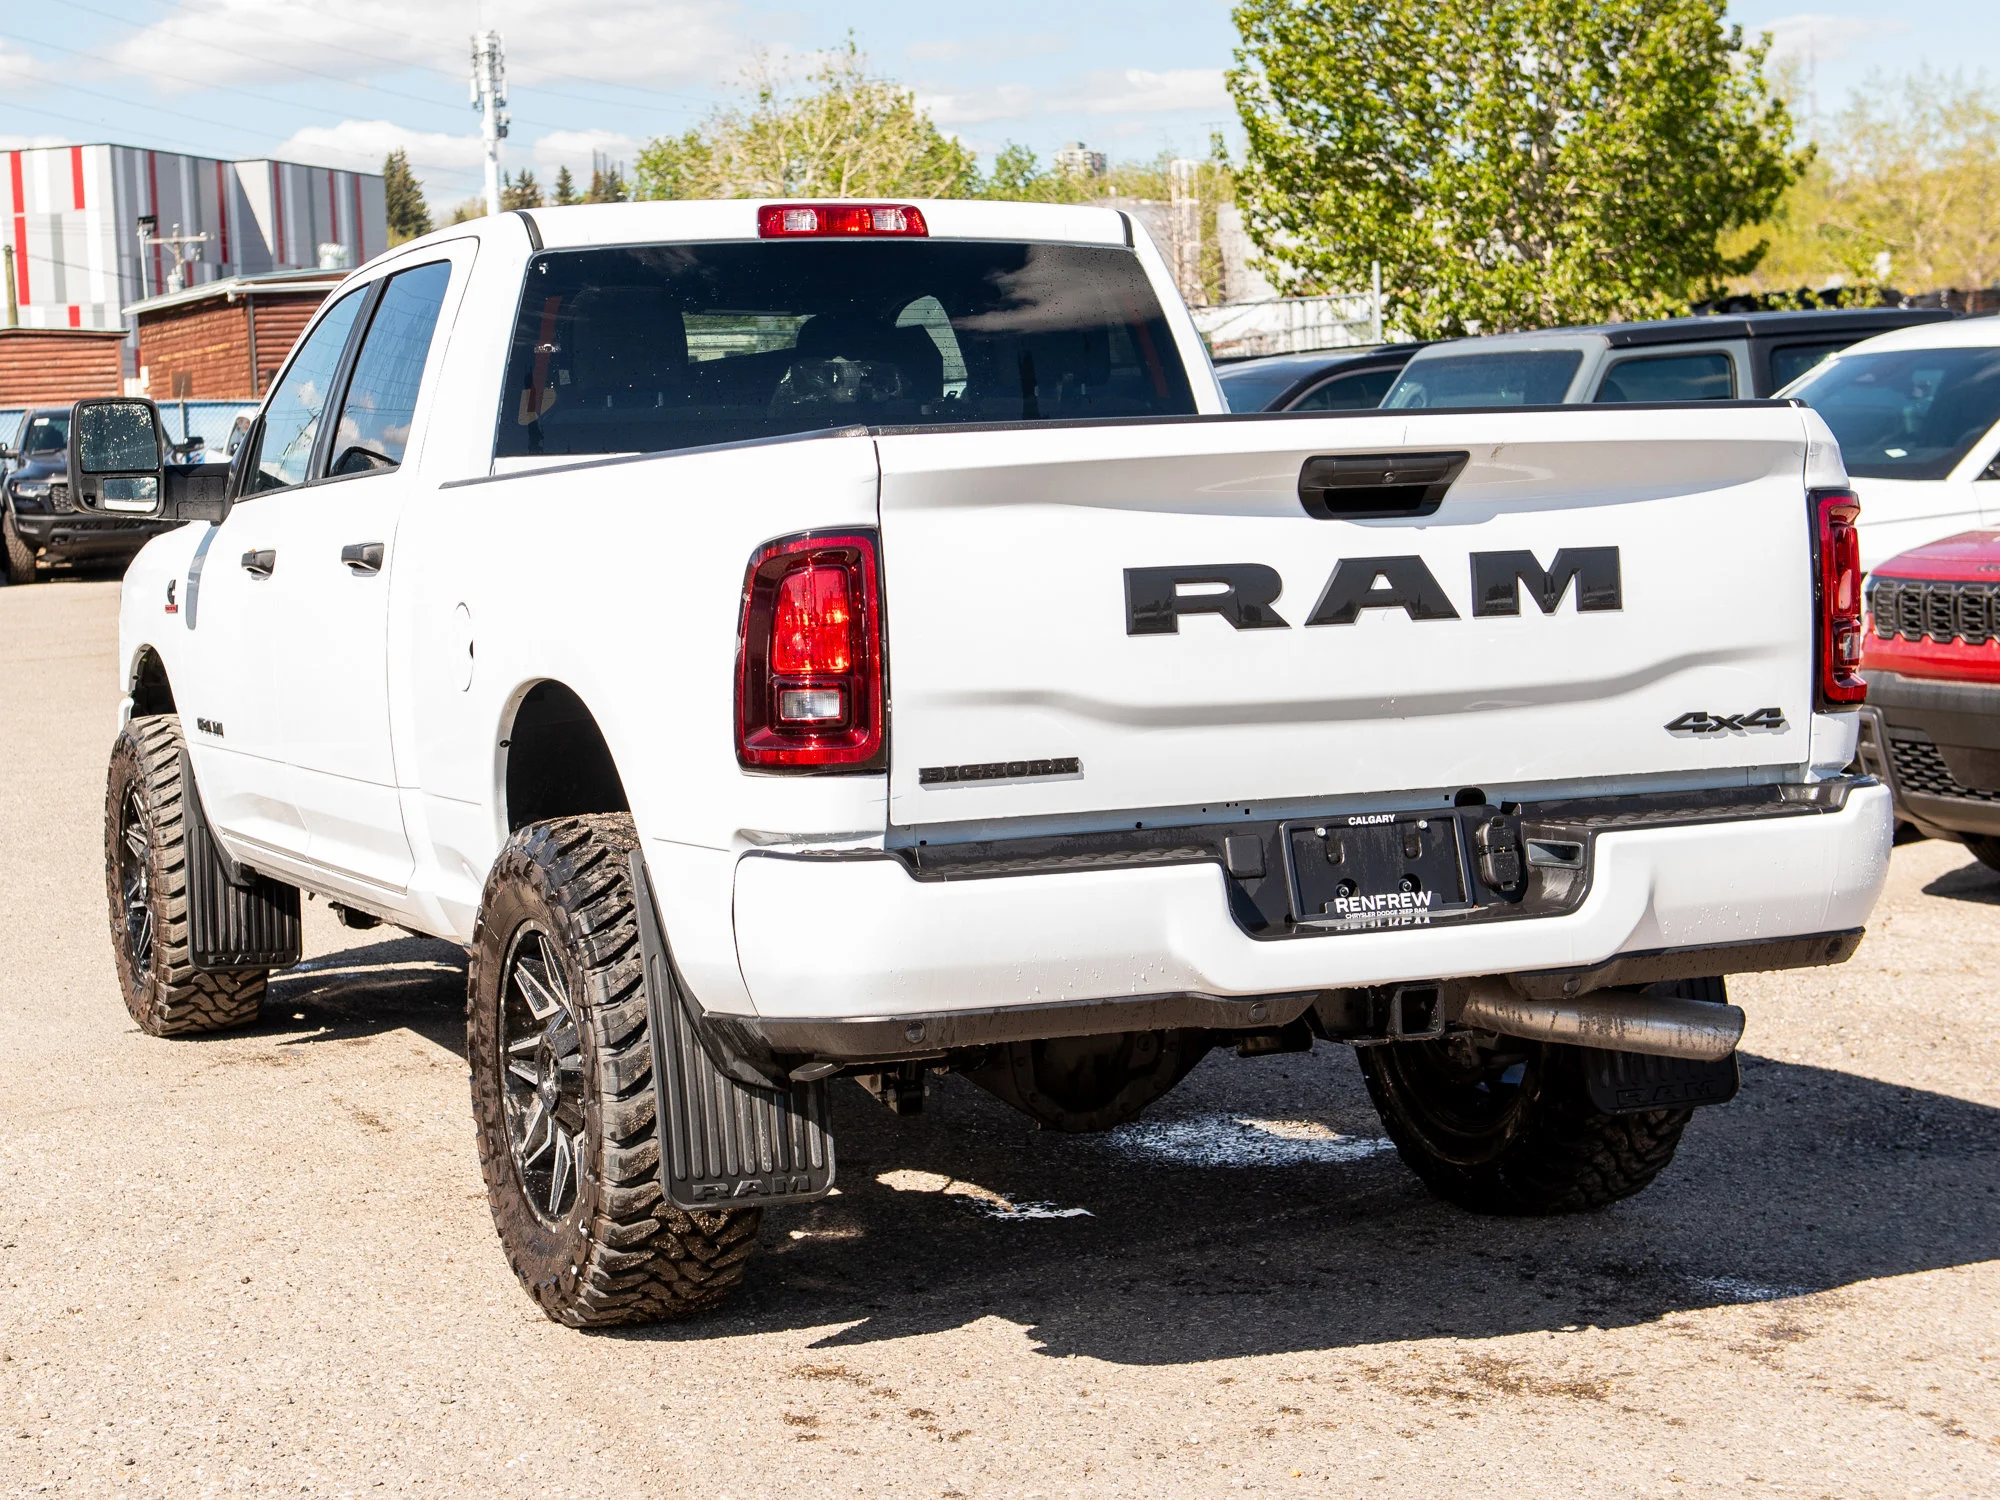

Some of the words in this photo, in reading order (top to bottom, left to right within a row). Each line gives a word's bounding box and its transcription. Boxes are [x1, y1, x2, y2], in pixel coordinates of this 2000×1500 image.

[1122, 545, 1624, 637] RAM
[1663, 706, 1787, 735] 4x4
[1347, 813, 1396, 826] CALGARY
[1334, 890, 1433, 914] RENFREW
[1345, 911, 1376, 920] CHRYSLER
[1376, 909, 1398, 917] DODGE
[1615, 1078, 1720, 1107] RAM
[692, 1174, 811, 1201] RAM
